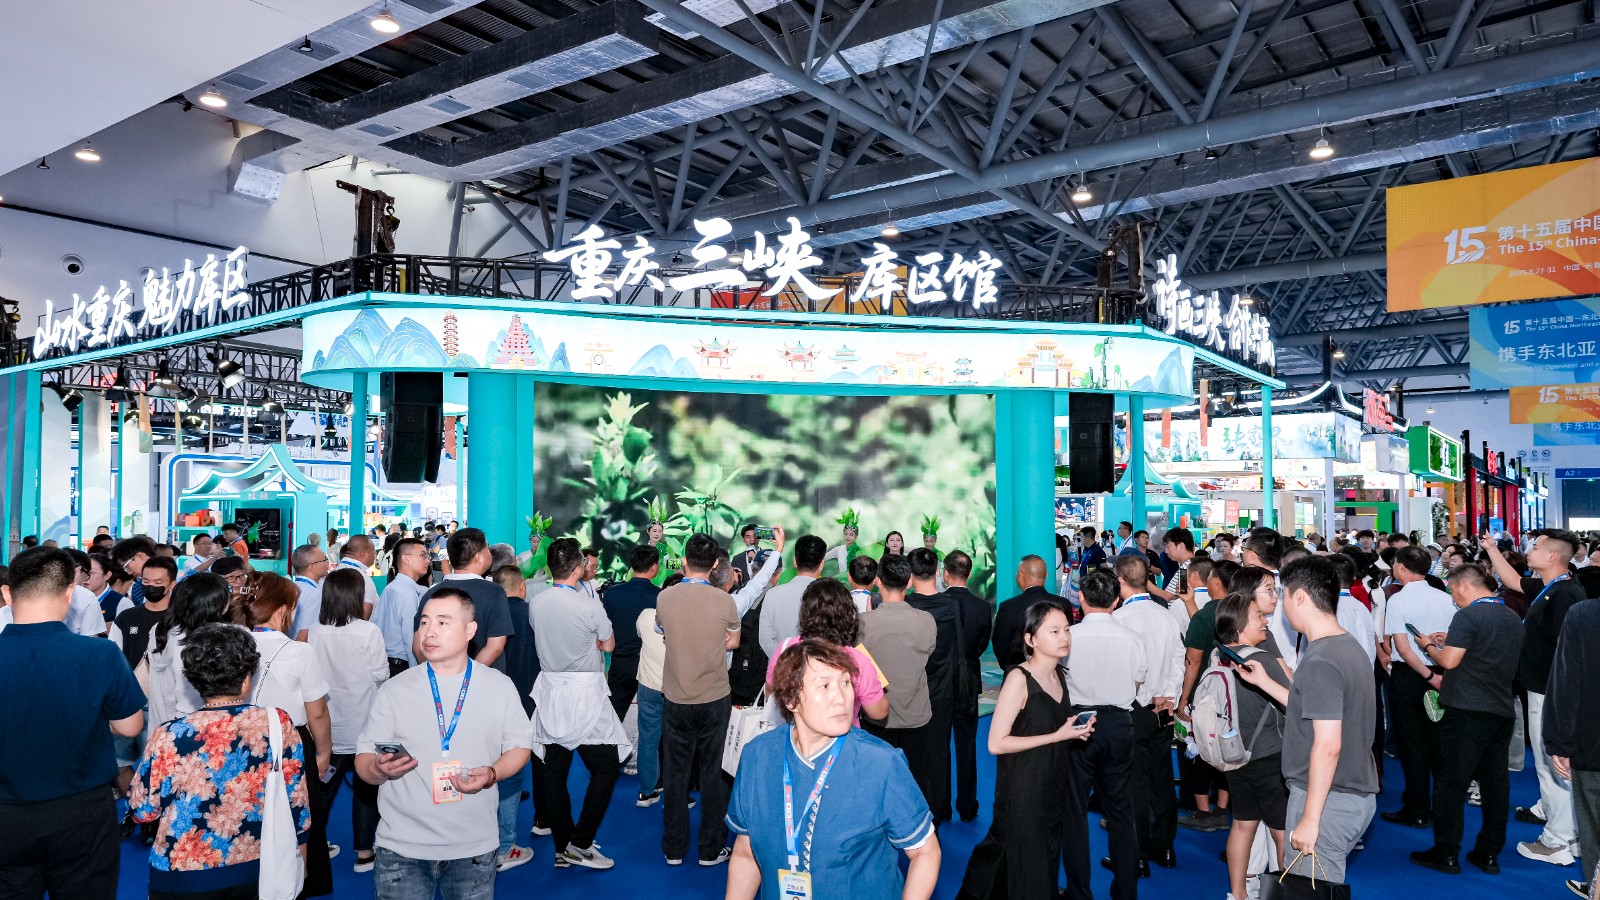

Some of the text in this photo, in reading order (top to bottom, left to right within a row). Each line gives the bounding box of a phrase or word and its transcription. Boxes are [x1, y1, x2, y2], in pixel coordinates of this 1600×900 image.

[1444, 226, 1487, 264] 15
[1499, 243, 1524, 255] The
[1504, 320, 1520, 335] 15
[1498, 340, 1597, 362] 携手东北亚
[1545, 363, 1579, 371] Openness
[1539, 386, 1560, 404] 15
